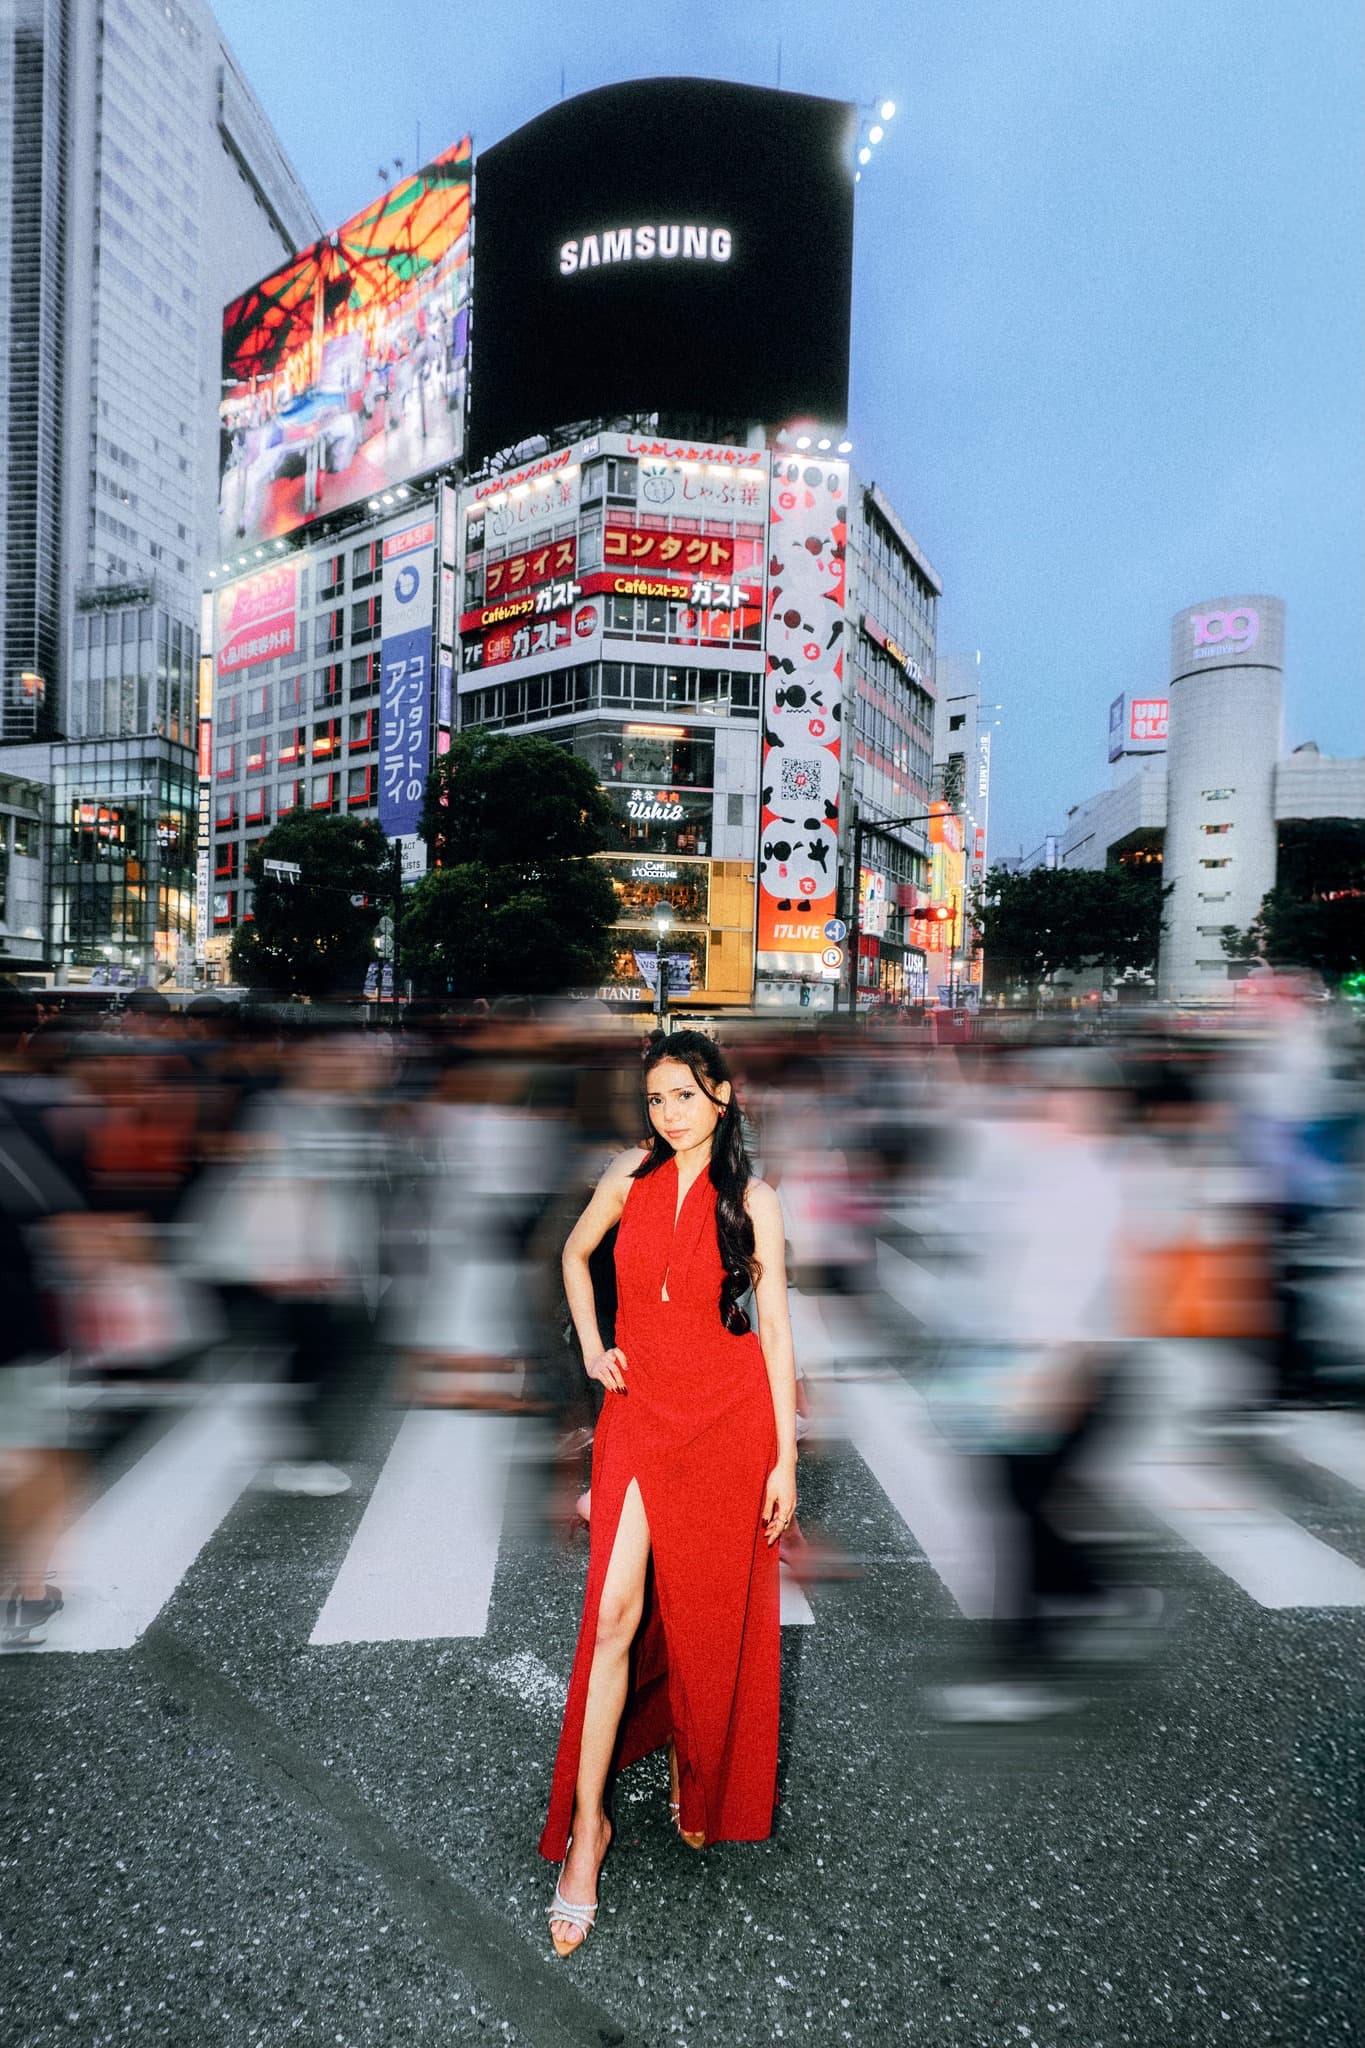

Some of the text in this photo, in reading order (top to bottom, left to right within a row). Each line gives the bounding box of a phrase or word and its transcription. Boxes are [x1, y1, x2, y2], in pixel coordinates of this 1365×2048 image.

[560, 225, 732, 275] SAMSUNG
[468, 520, 485, 540] 9F
[605, 532, 731, 566] コンタクト
[535, 580, 582, 614] ガスト
[691, 581, 750, 607] ガスト
[511, 619, 567, 660] ガスト
[1190, 607, 1259, 655] 109
[464, 643, 484, 665] 7F
[1134, 703, 1167, 720] UNI
[384, 659, 407, 804] アイシティ
[406, 655, 424, 801] コンタクトの
[1133, 720, 1168, 738] QLO
[627, 801, 684, 821] Ushi8
[773, 924, 821, 940] 17LIVE
[904, 952, 924, 973] LUSH
